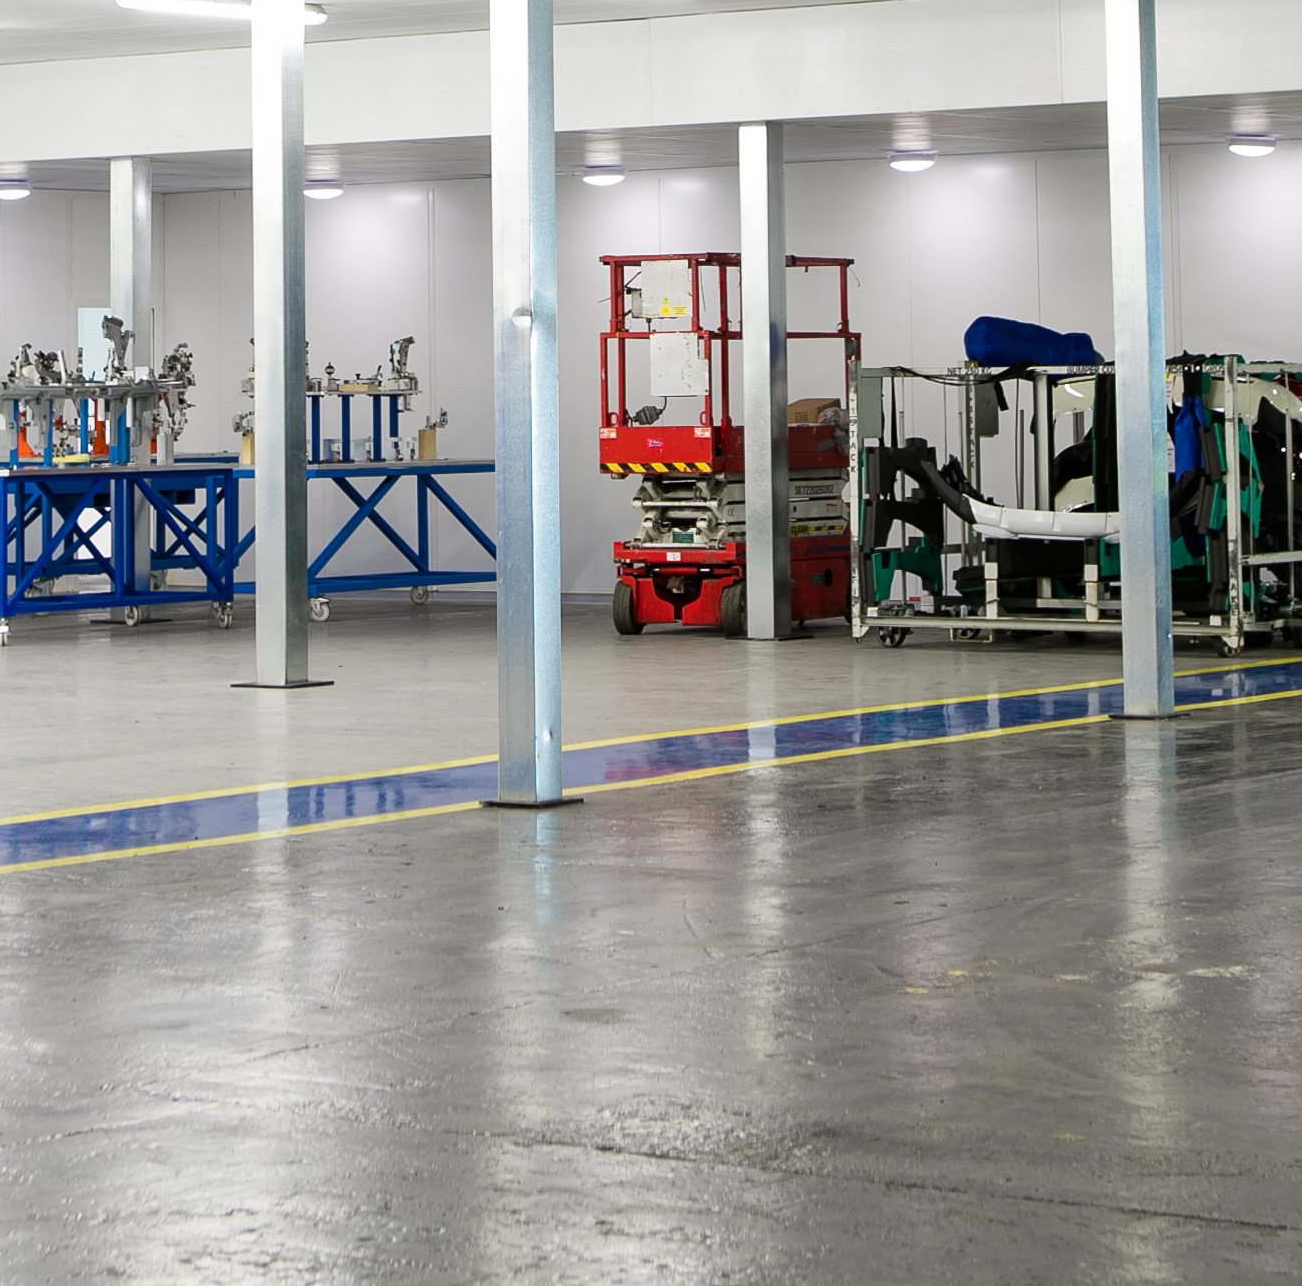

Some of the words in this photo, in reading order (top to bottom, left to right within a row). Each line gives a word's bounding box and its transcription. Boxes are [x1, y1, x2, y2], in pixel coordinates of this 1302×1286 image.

[947, 367, 962, 376] NET
[981, 366, 992, 376] KG
[1067, 365, 1100, 374] BUMPER
[1101, 365, 1115, 374] CO
[1204, 364, 1225, 374] GROS
[790, 525, 808, 534] CLEAR
